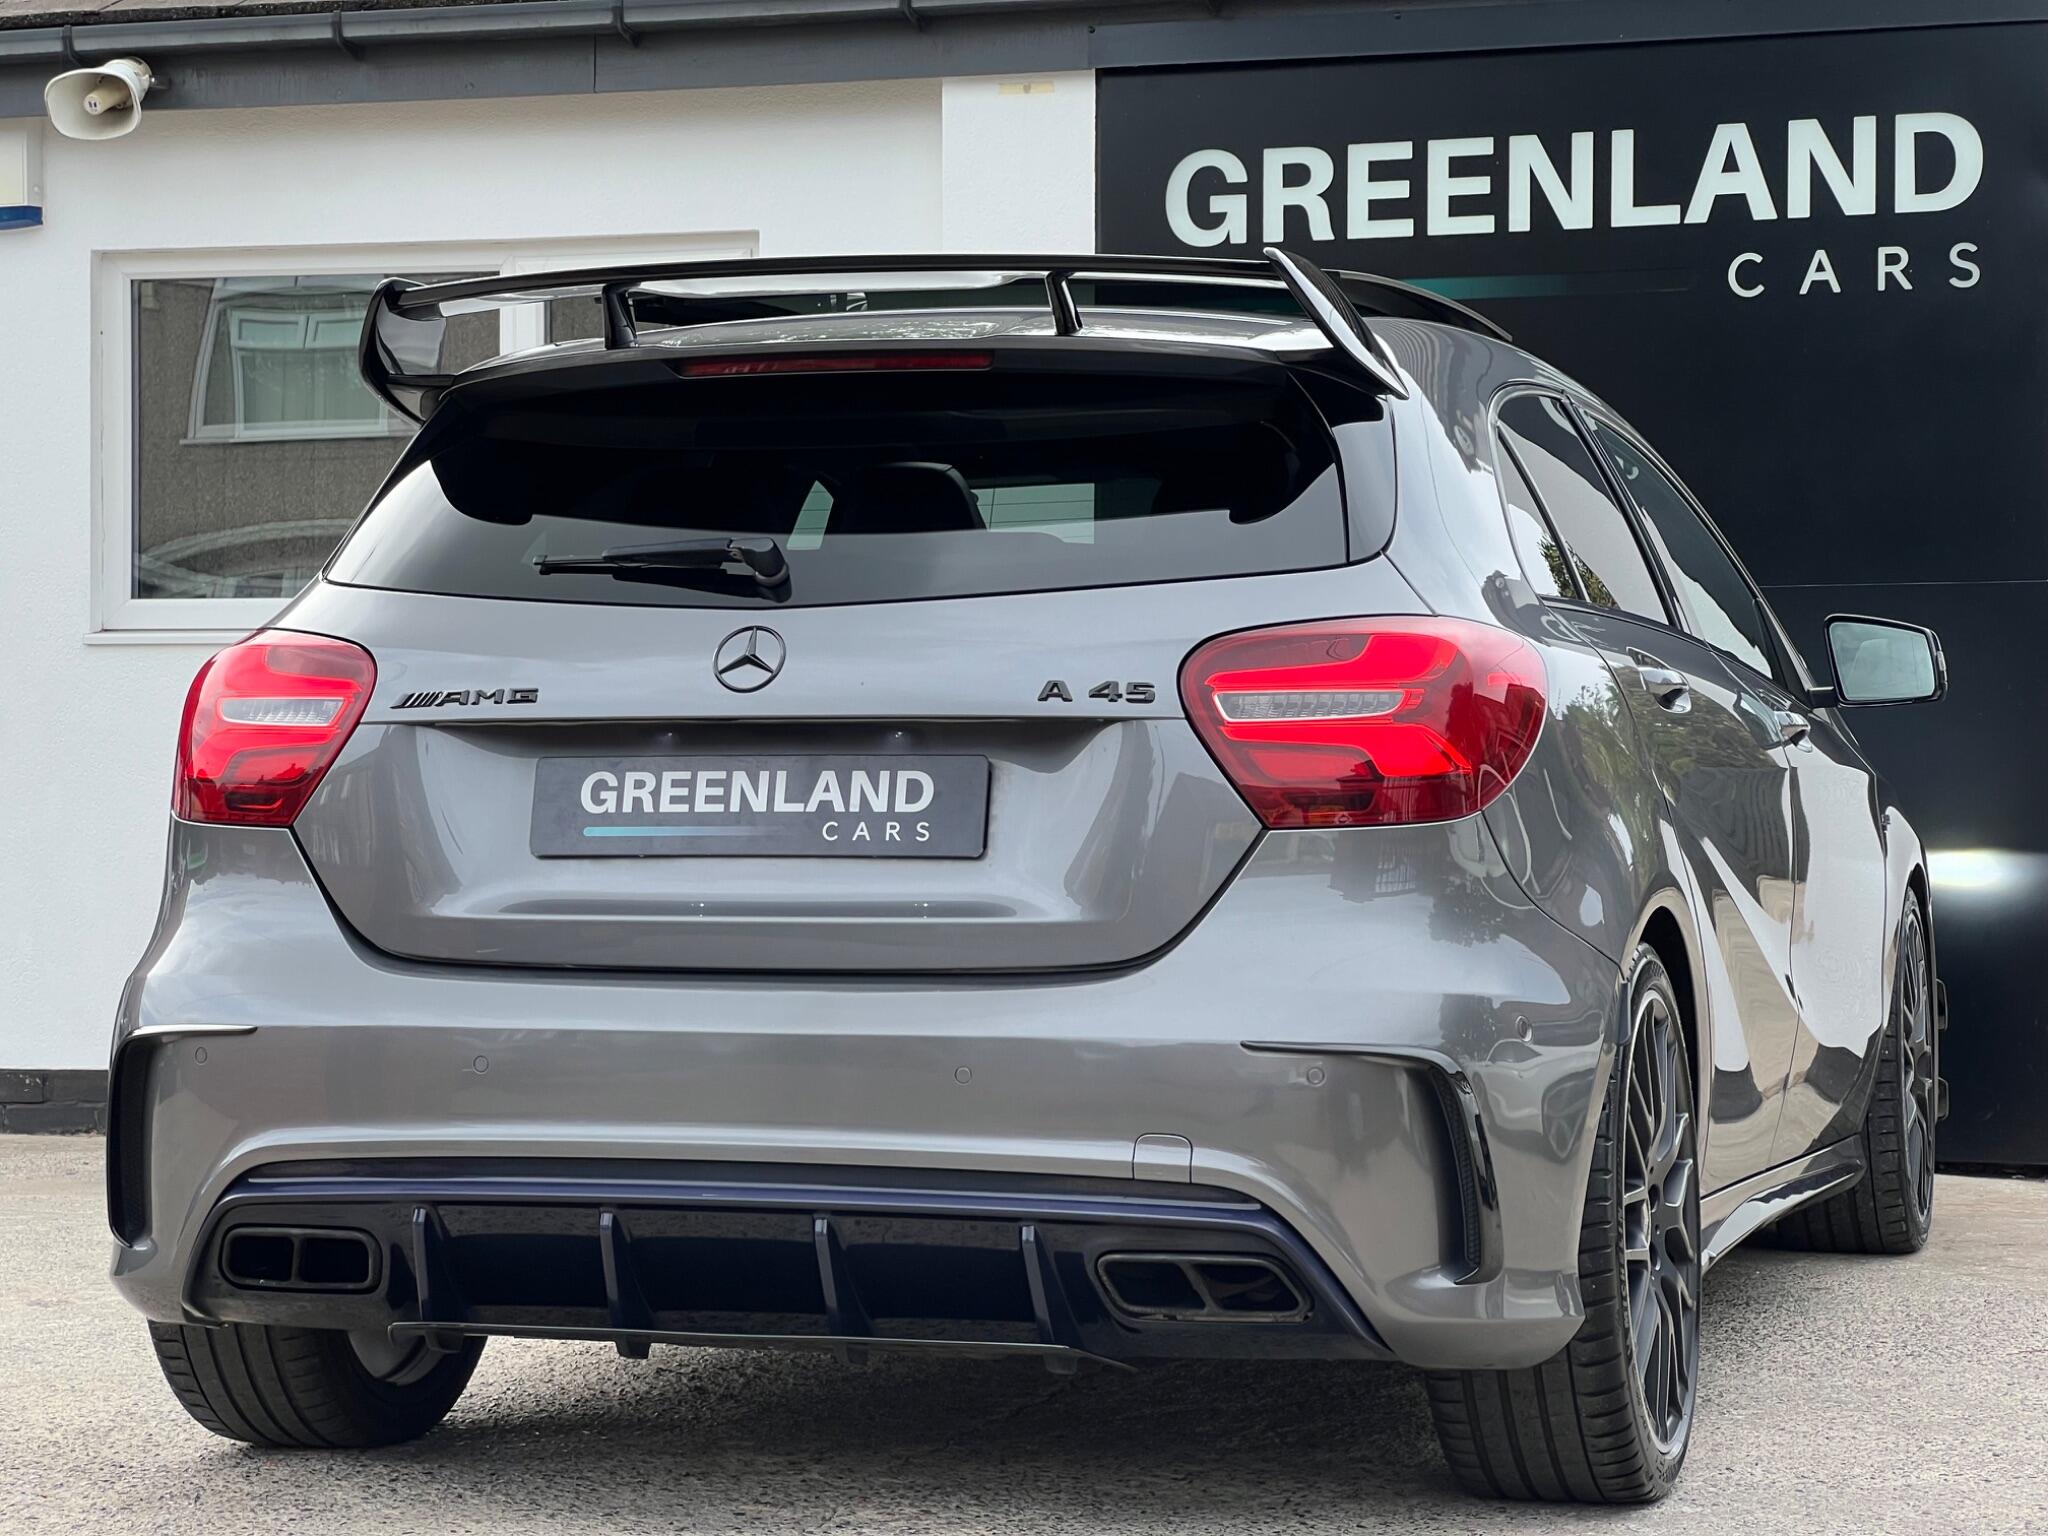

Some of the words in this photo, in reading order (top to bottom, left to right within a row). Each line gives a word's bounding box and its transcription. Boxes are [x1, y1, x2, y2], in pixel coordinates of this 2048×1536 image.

[1165, 112, 1984, 247] GREENLAND
[1727, 242, 1981, 298] CARS
[1037, 680, 1073, 702] A
[1088, 680, 1156, 704] 45
[580, 770, 935, 814] GREENLAND
[822, 821, 930, 841] CARS
